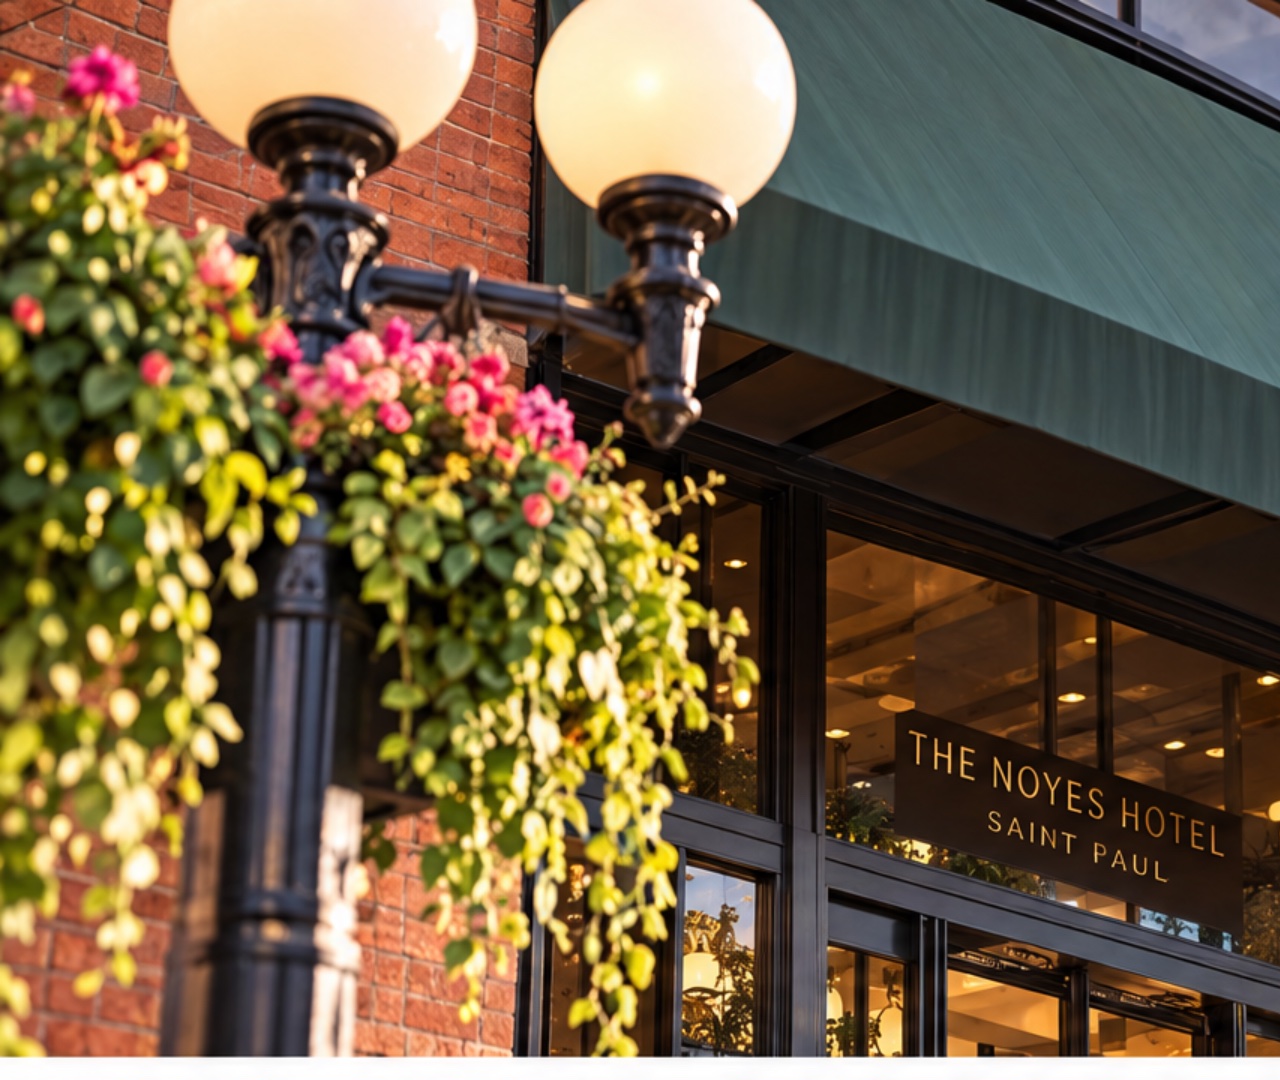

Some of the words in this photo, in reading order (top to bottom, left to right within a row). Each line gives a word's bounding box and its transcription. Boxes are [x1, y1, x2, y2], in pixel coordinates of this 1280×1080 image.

[908, 729, 976, 782] THE
[992, 756, 1105, 820] NOYES
[1121, 797, 1225, 857] HOTEL
[987, 810, 1078, 855] SAINT
[1093, 841, 1169, 883] PAUL
